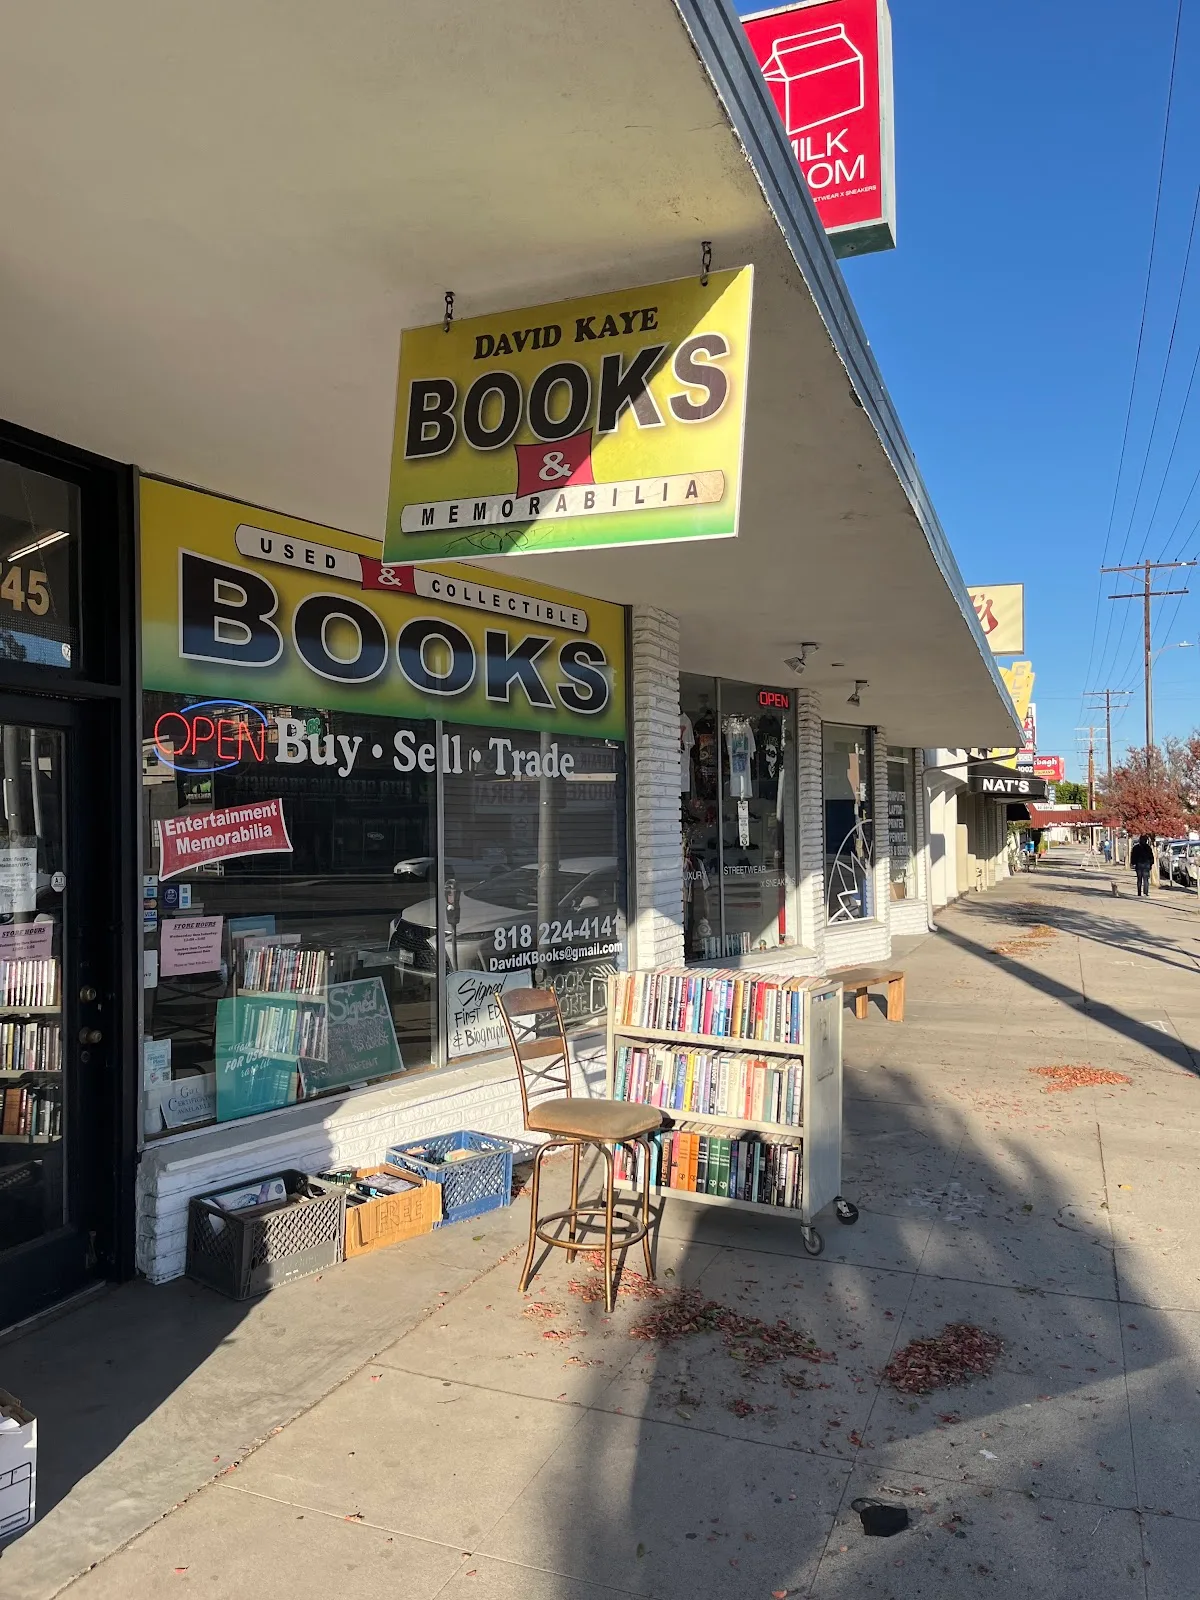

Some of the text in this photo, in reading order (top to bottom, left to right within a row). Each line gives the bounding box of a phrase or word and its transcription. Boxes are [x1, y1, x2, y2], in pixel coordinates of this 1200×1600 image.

[802, 154, 865, 189] OM
[845, 185, 877, 196] SNEAKERS
[472, 307, 659, 360] DAVID KAYE
[403, 331, 731, 461] BOOKS
[538, 450, 572, 481] &
[421, 479, 699, 526] MEMORABILIA
[0, 563, 50, 616] 45
[259, 537, 580, 626] USED & COLLECTIBLE
[178, 547, 611, 714] BOOKS
[759, 691, 789, 708] OPEN
[154, 712, 265, 762] OPEN
[274, 717, 575, 778] Buy Sell Trade
[982, 778, 1030, 794] NAT'S
[164, 801, 278, 837] Entertainment
[175, 823, 273, 855] Memorabilia
[723, 865, 766, 875] STREETWEAR
[25, 927, 46, 935] HOURS
[493, 915, 620, 951] 818 224-4141
[489, 941, 623, 972] DavidKBooks@gmail.com
[329, 987, 377, 1025] Signed
[457, 974, 508, 1007] Signed
[454, 1004, 481, 1028] First
[225, 1055, 245, 1074] FOR
[376, 1195, 424, 1233] FREE
